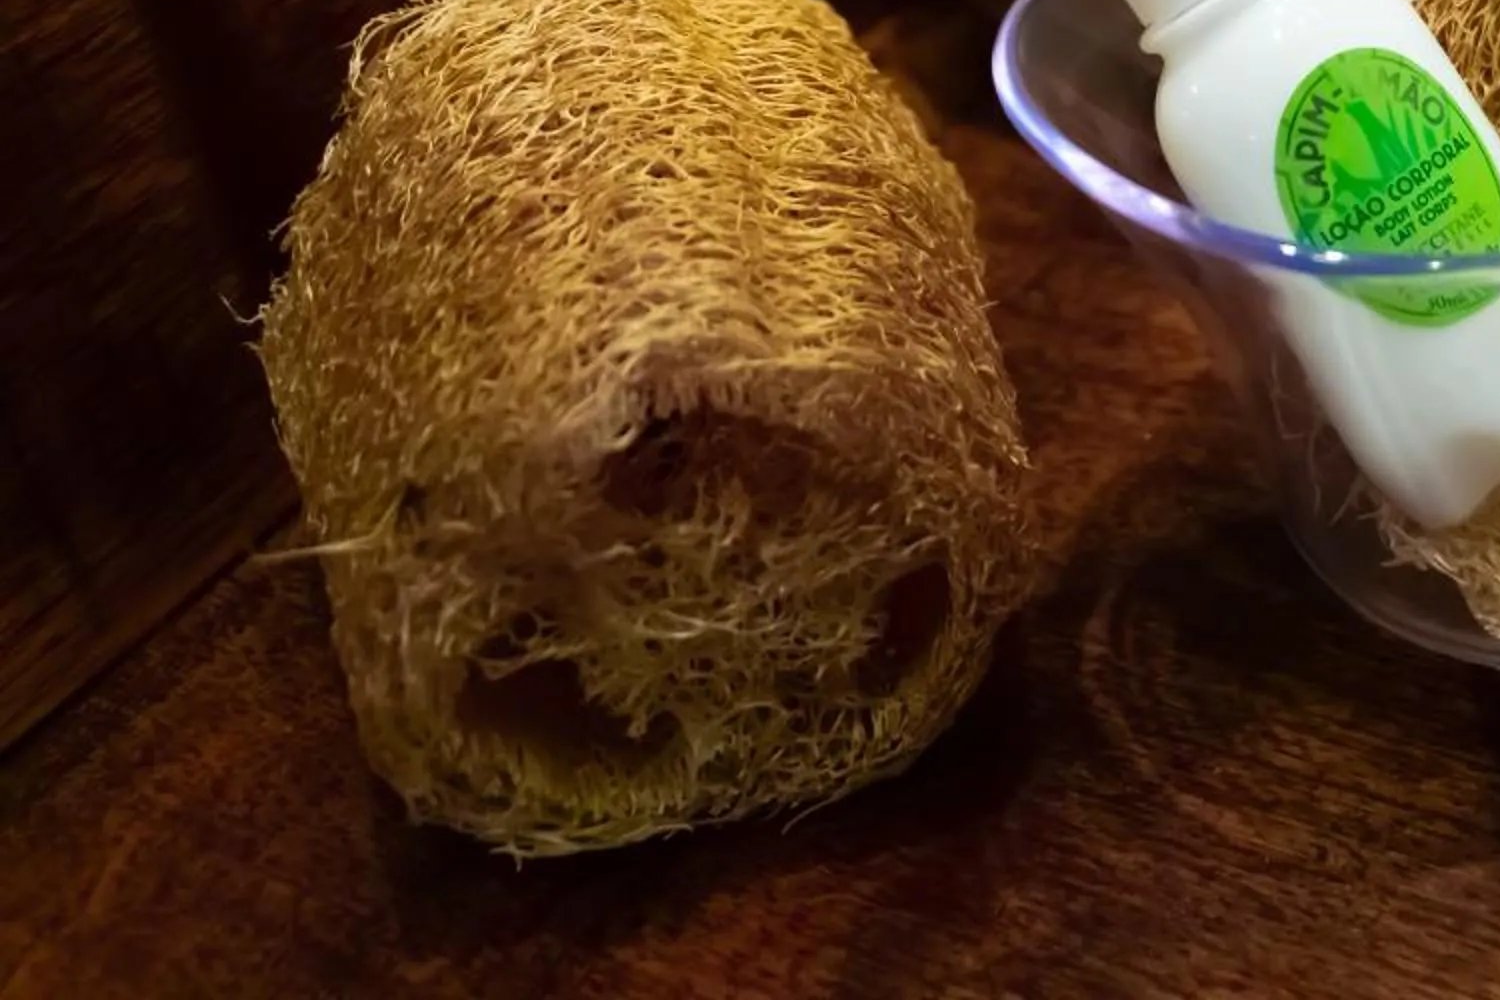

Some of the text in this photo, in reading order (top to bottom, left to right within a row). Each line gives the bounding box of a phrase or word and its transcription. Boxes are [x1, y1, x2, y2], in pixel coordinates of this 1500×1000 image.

[1388, 132, 1470, 201] CORPORAL
[1374, 173, 1454, 237] BODY LOTION
[1418, 193, 1457, 226] CORPS
